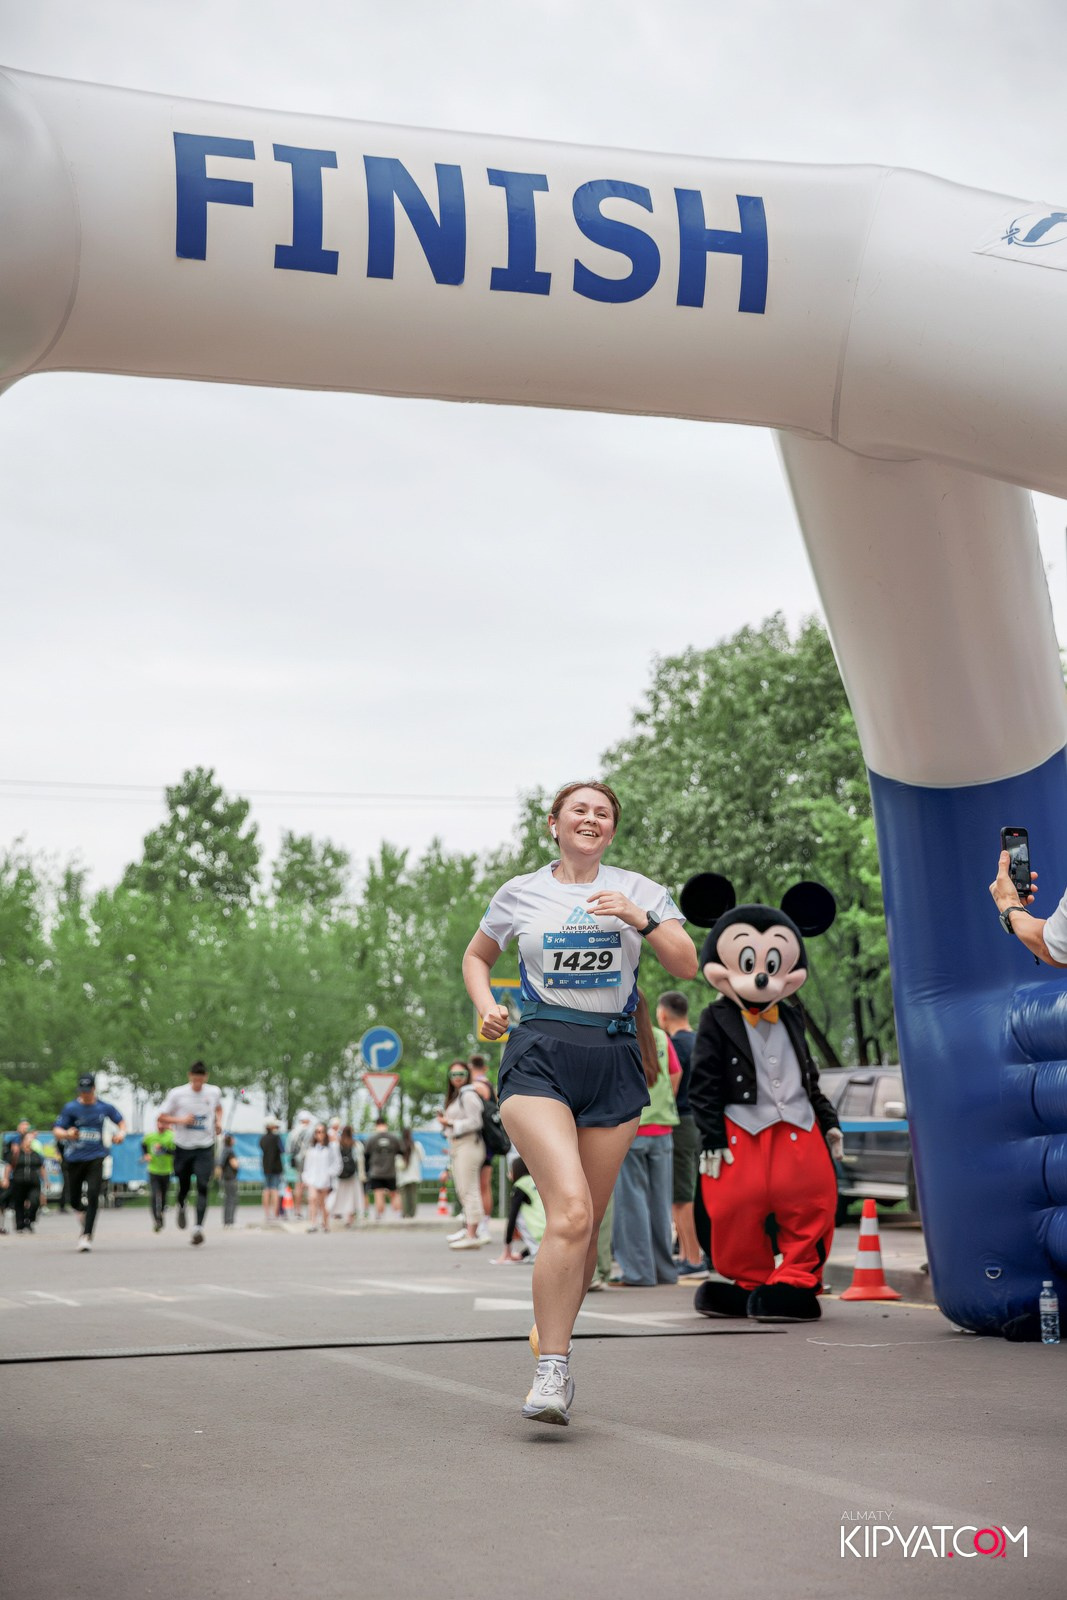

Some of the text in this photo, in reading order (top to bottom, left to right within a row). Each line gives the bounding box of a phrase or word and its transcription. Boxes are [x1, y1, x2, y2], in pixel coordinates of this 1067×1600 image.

[174, 132, 767, 314] FINISH
[547, 936, 553, 944] 5
[554, 951, 613, 971] 1429
